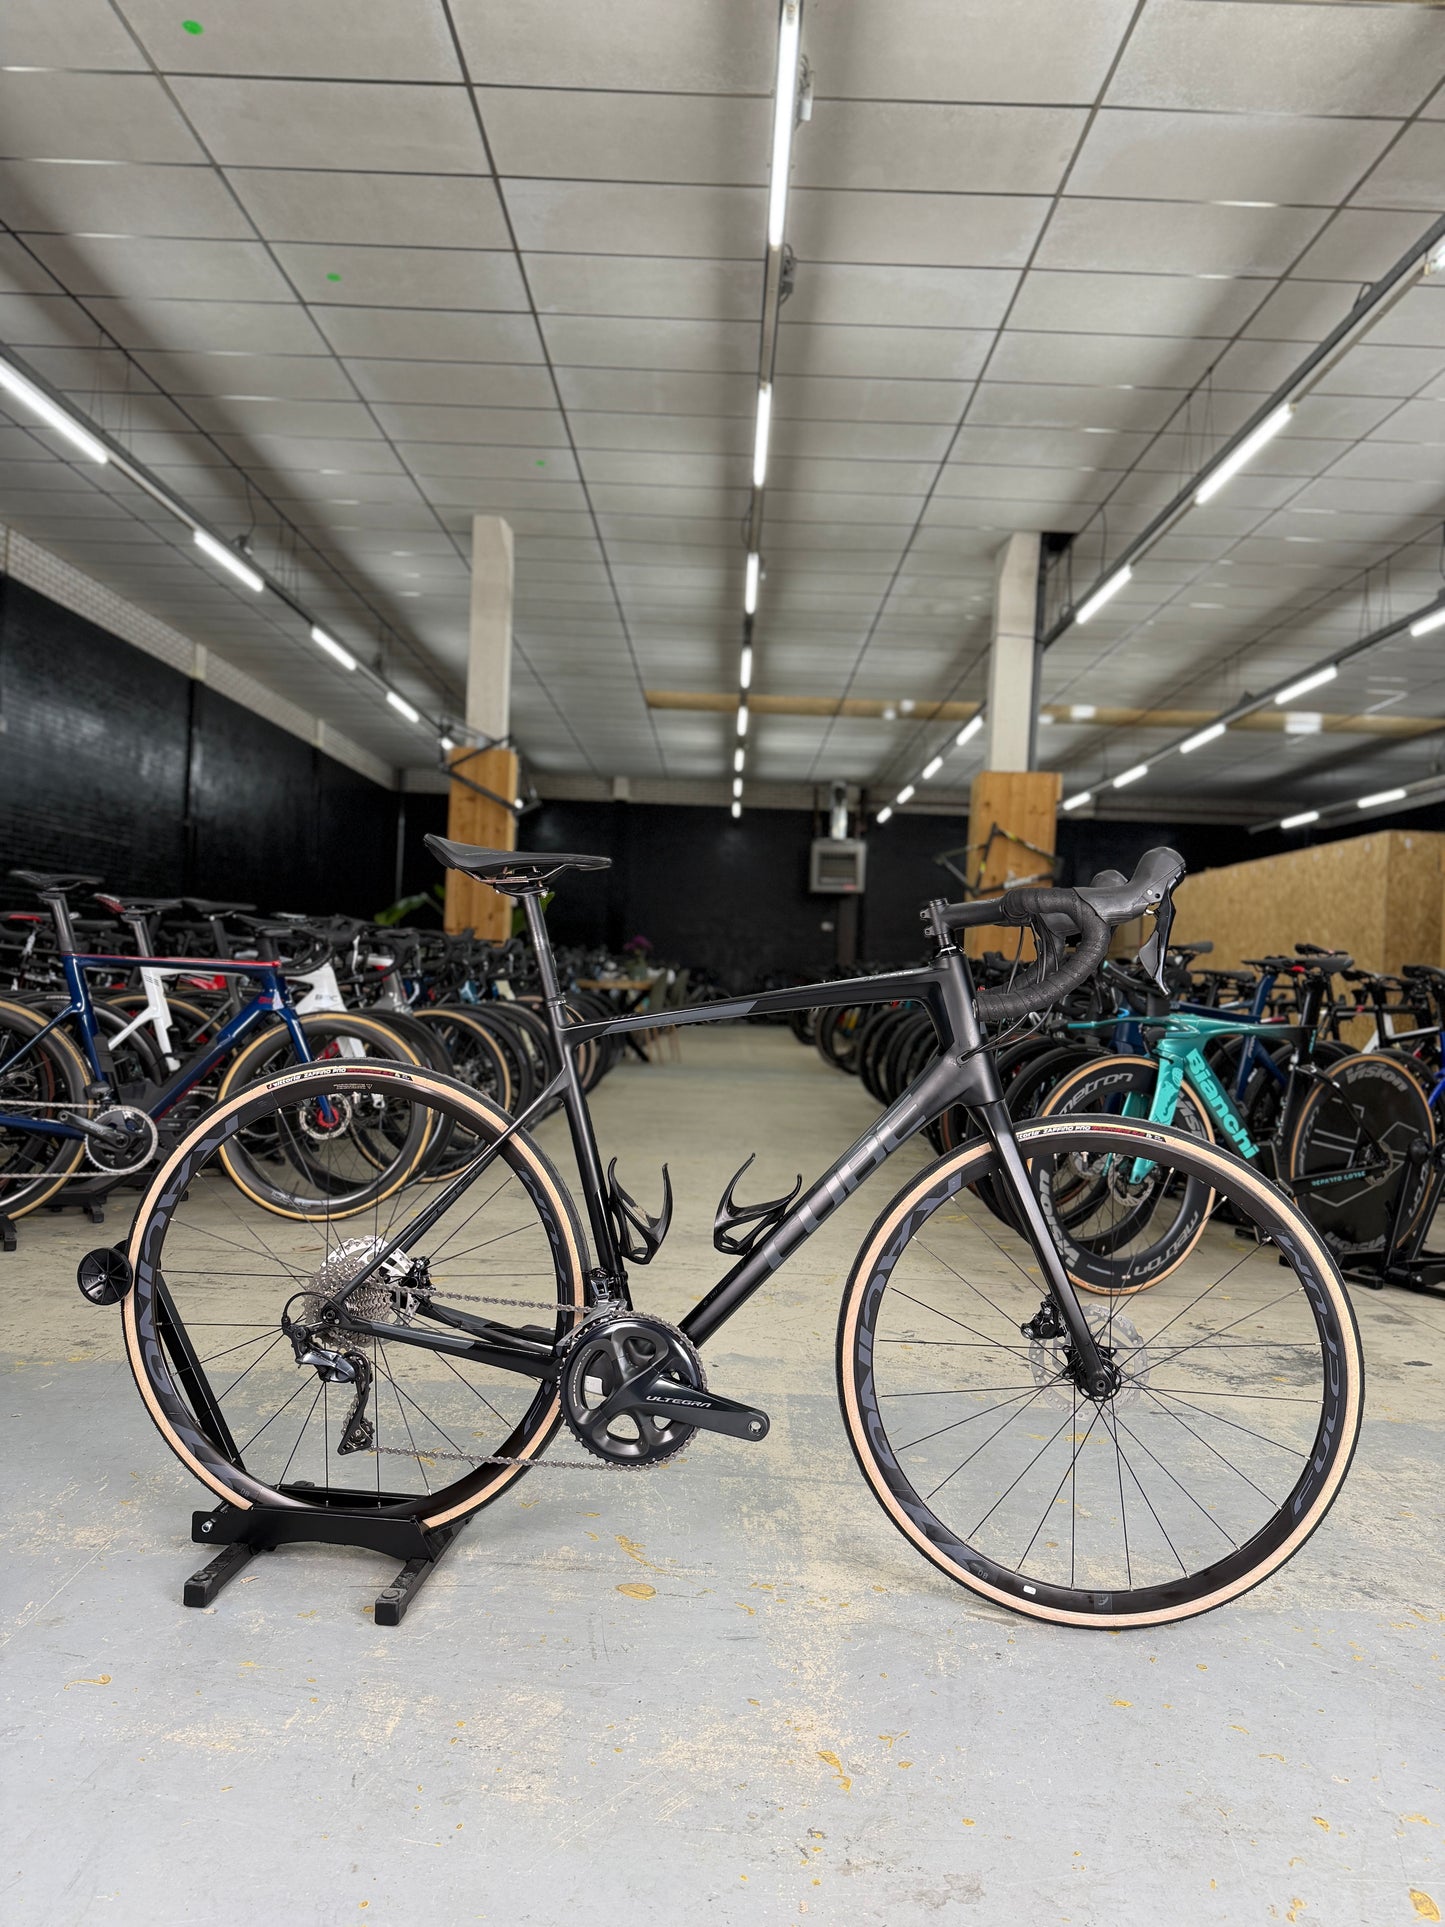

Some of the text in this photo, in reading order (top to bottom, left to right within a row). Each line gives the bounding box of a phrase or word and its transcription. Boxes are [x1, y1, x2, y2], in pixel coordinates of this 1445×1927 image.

[1058, 1073, 1134, 1115] metron
[1185, 1047, 1260, 1159] Bianchi
[762, 1093, 927, 1269] CUBE
[1134, 1210, 1199, 1276] metron
[646, 1395, 712, 1408] ULTEGRA
[1275, 1234, 1341, 1515] FULCRUM
